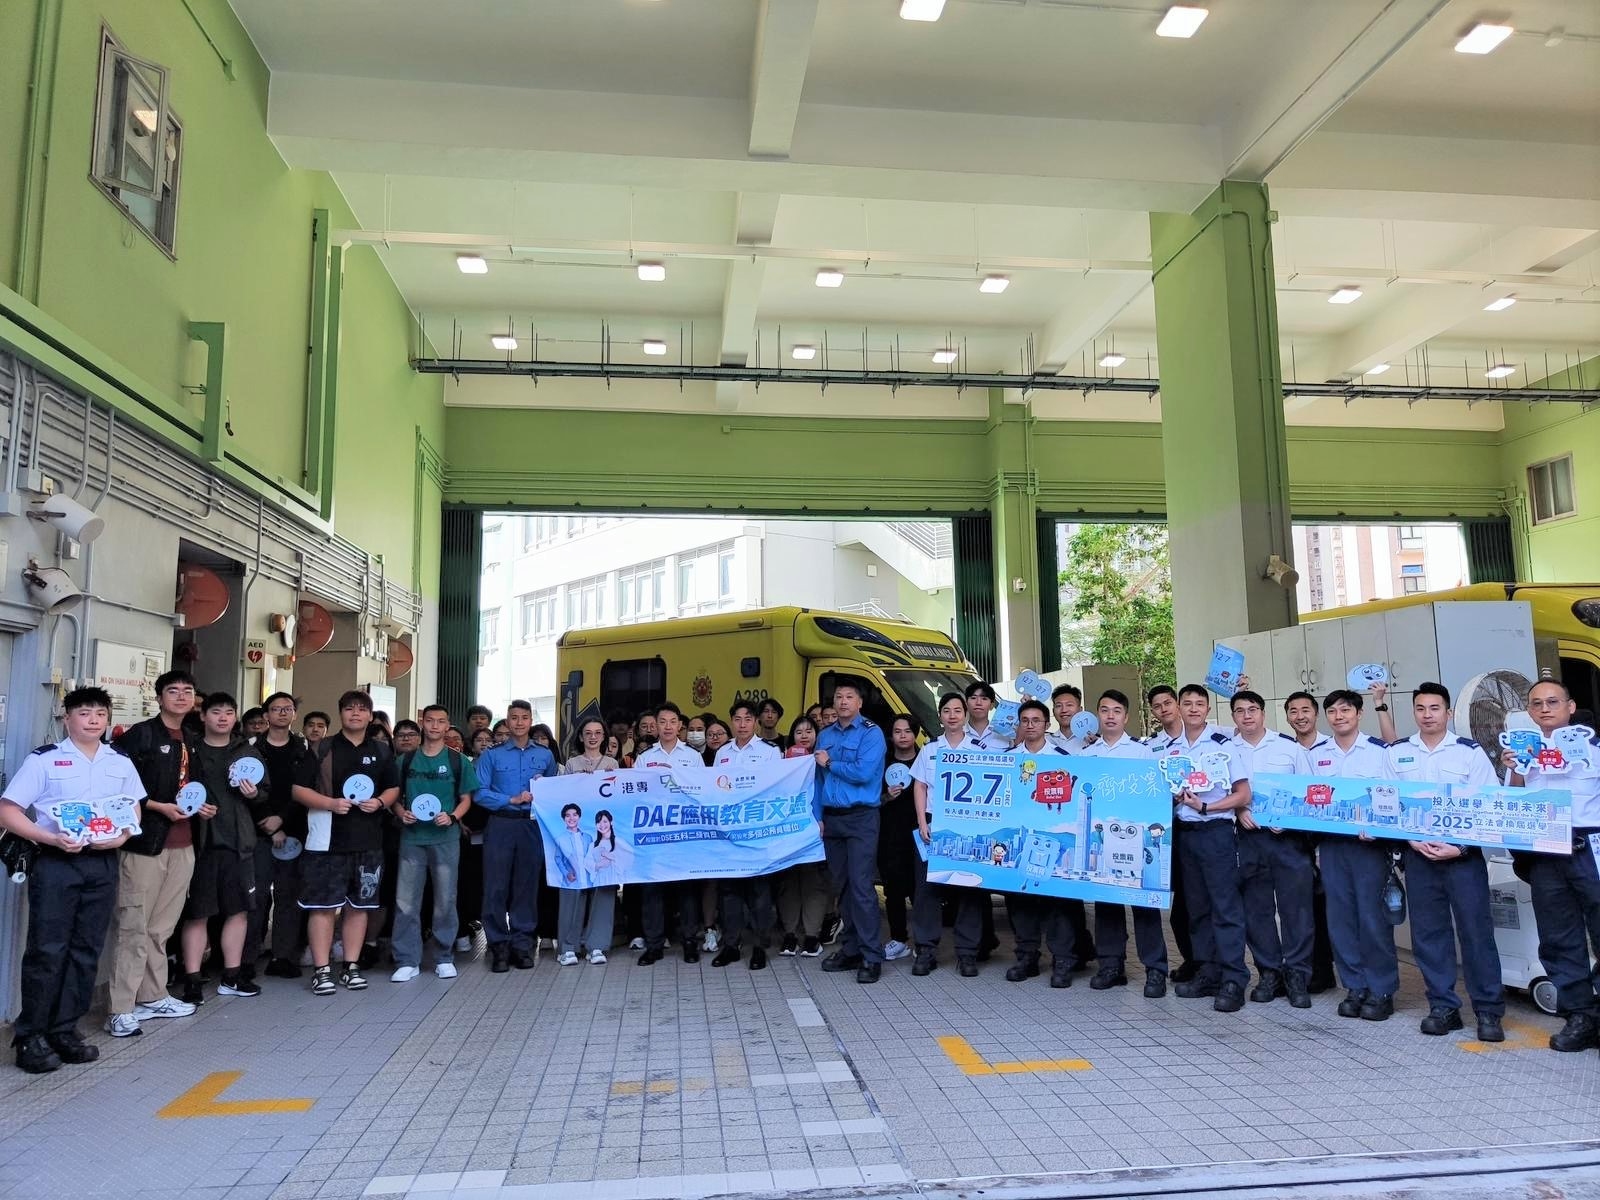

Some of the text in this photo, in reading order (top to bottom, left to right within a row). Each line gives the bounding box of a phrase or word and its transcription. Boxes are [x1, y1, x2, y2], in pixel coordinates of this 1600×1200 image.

[906, 644, 955, 659] AMBULANCE
[734, 689, 768, 705] A289
[622, 781, 648, 794] 港專
[1432, 796, 1547, 813] 投入選舉 共創未來
